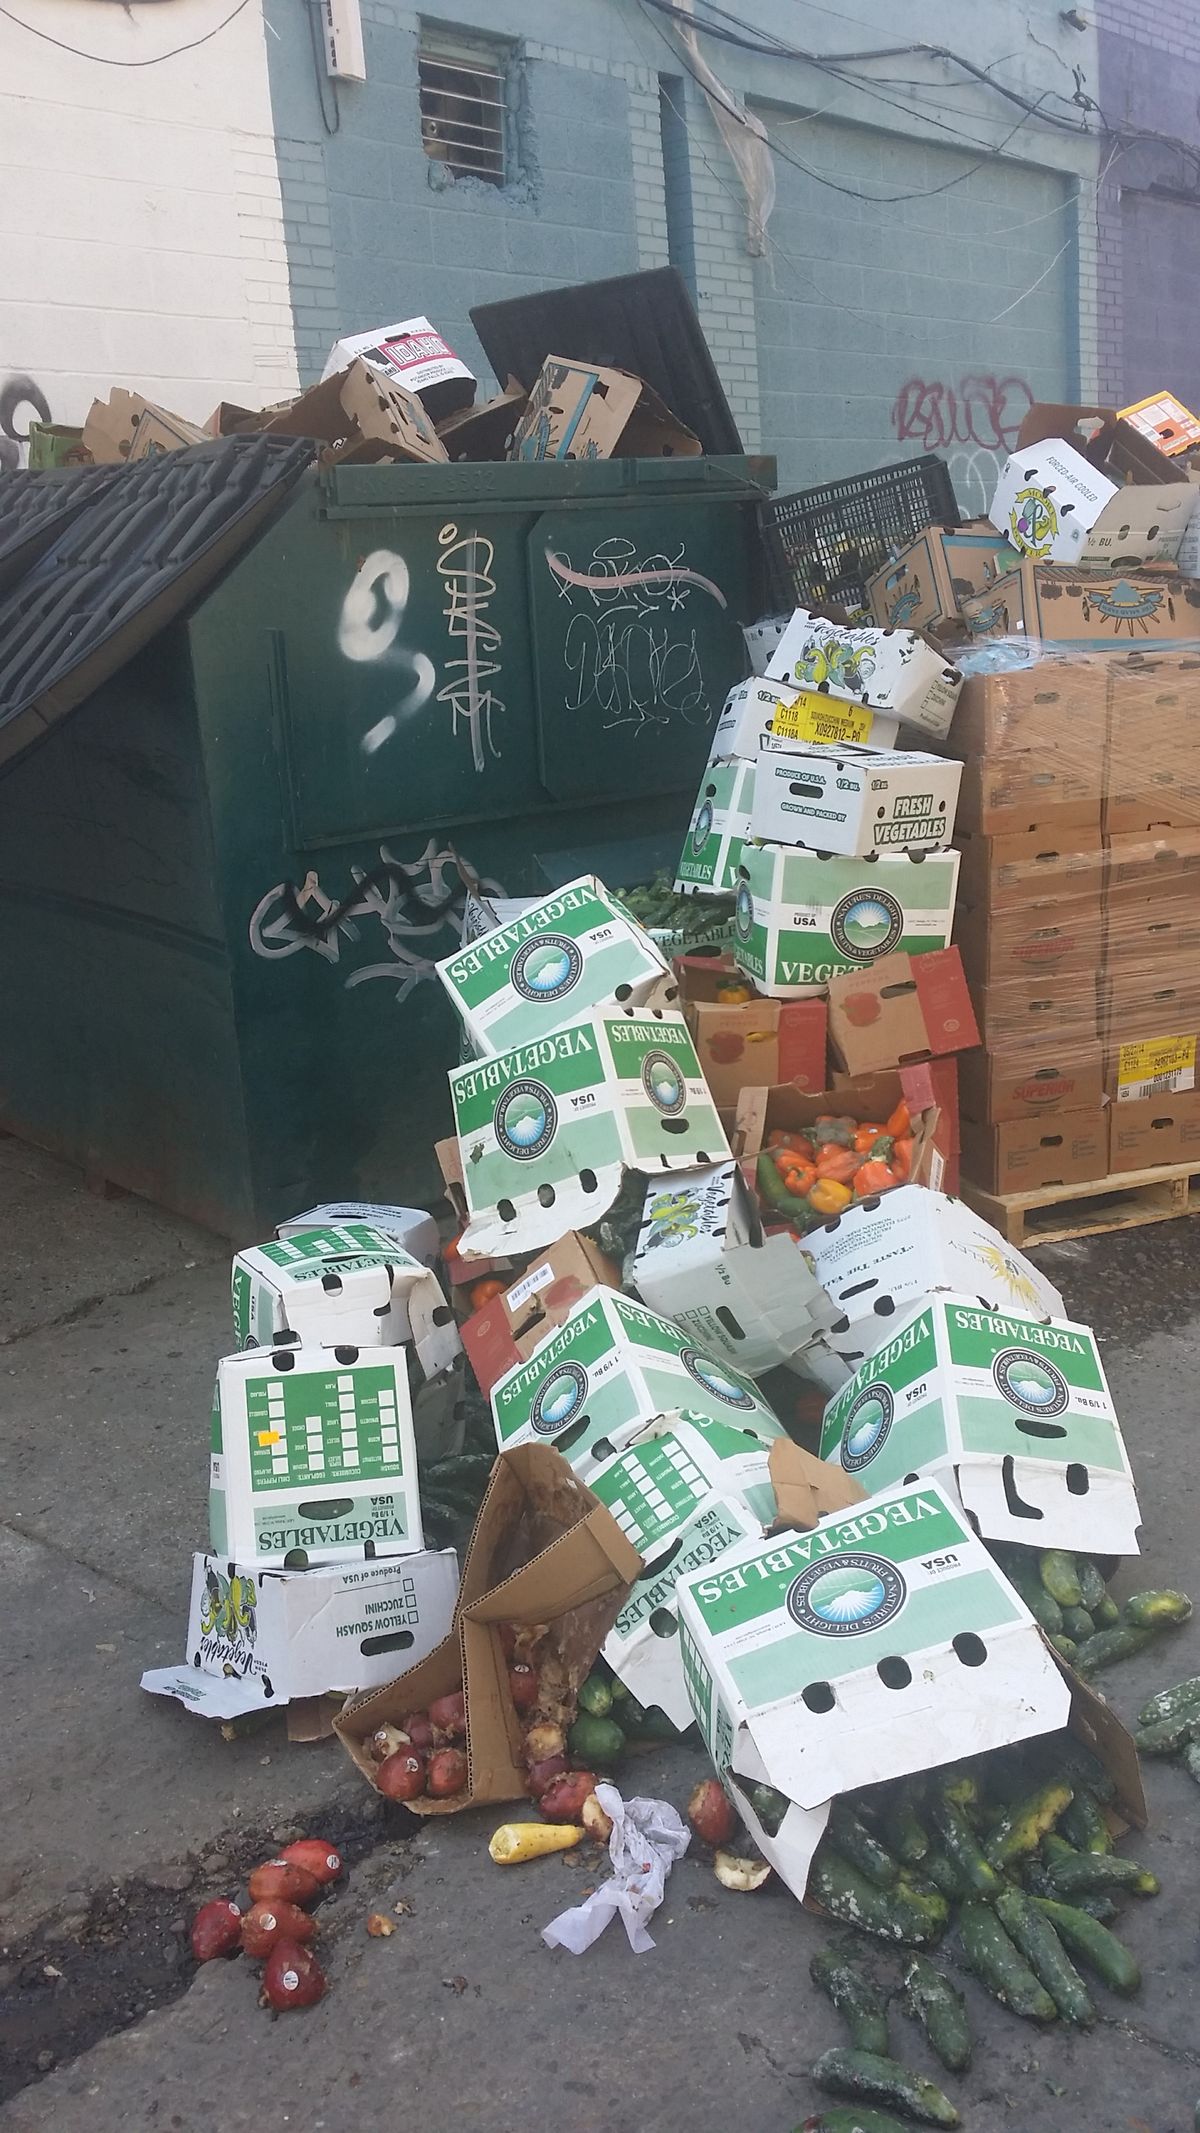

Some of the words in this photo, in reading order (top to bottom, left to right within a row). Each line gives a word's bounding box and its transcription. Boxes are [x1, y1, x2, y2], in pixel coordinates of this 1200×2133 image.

[384, 336, 451, 365] IDAHO
[1074, 482, 1098, 502] COOLED
[1098, 537, 1113, 547] BU.
[814, 622, 880, 646] Vegetables
[775, 768, 801, 779] PRODUCE
[801, 773, 810, 781] OF
[836, 778, 849, 789] 1/2
[781, 802, 803, 814] GROWN
[803, 806, 816, 816] AND
[816, 808, 838, 821] PACKED
[838, 813, 847, 822] BY
[893, 794, 933, 819] FRESH
[874, 817, 946, 846] VEGETABLES
[837, 892, 871, 920] NATURE'S
[872, 893, 899, 921] DELIGHT
[793, 916, 817, 927] USA
[450, 885, 601, 984] VEGETABLES
[588, 928, 612, 941] USA
[611, 1024, 688, 1044] VEGETABLES
[454, 1030, 593, 1104] VEGETABLES
[1012, 1079, 1076, 1100] SUPERIOR
[570, 1093, 595, 1107] USA
[698, 1182, 728, 1235] Vegetables
[294, 1254, 414, 1281] VEGETABLES
[847, 1263, 871, 1276] THE
[955, 1310, 1086, 1355] VEGETABLES
[502, 1312, 598, 1406] VEGETABLES
[905, 1383, 927, 1401] USA
[370, 1495, 394, 1505] USA
[694, 1510, 717, 1529] USA
[258, 1518, 405, 1550] VEGETABLES
[698, 1496, 943, 1605] VEGETABLES
[370, 1566, 402, 1577] Produce
[920, 1553, 958, 1570] USA
[936, 1562, 962, 1575] PRODUCT
[342, 1575, 360, 1585] USA
[360, 1571, 370, 1582] of
[614, 1526, 742, 1634] VEGETABLES
[364, 1599, 405, 1615] ZUCCHINI
[861, 1583, 898, 1628] NATURE'S
[336, 1619, 373, 1638] SQUASH
[374, 1612, 408, 1629] YELLOW
[803, 1614, 860, 1632] DELIGHT
[200, 1636, 257, 1676] Vegetables
